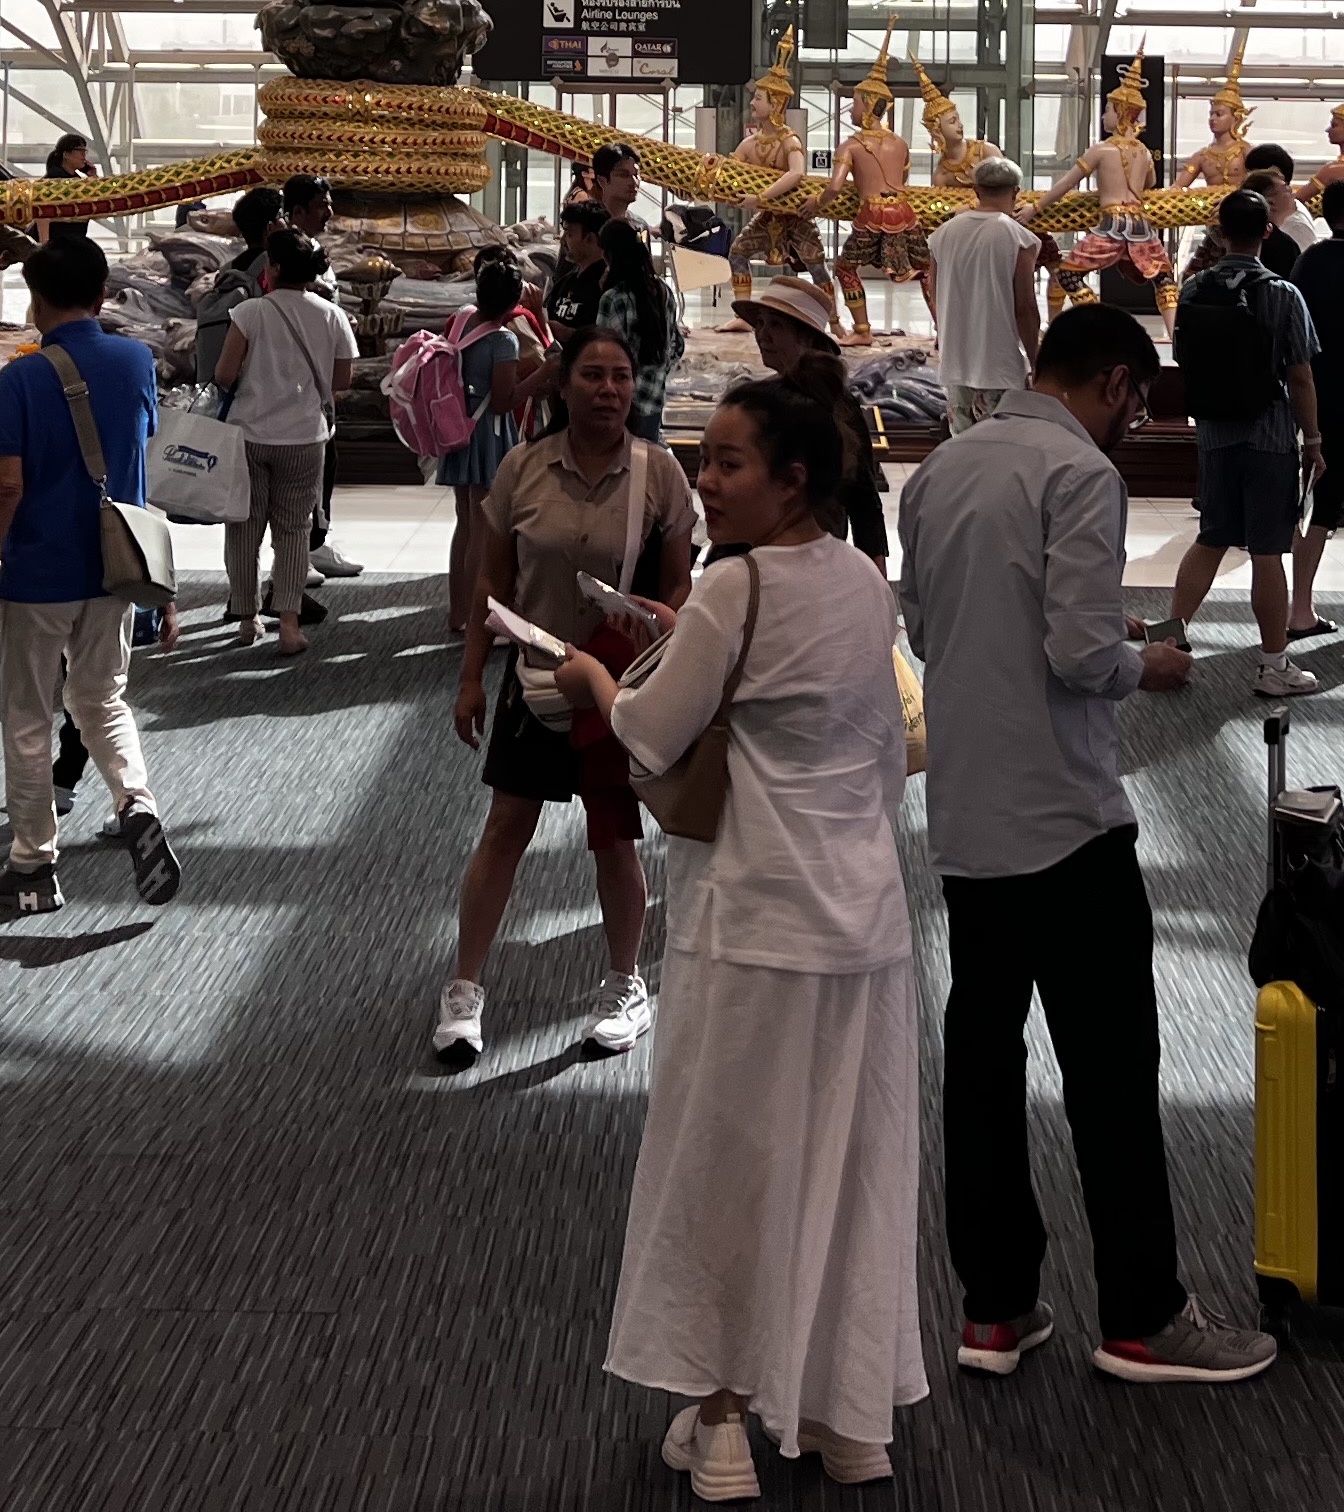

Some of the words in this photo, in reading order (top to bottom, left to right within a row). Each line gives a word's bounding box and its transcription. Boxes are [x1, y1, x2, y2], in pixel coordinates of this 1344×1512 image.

[581, 9, 612, 19] Airline
[615, 10, 658, 21] Lounges
[560, 41, 582, 49] THAI
[639, 63, 675, 76] Coral
